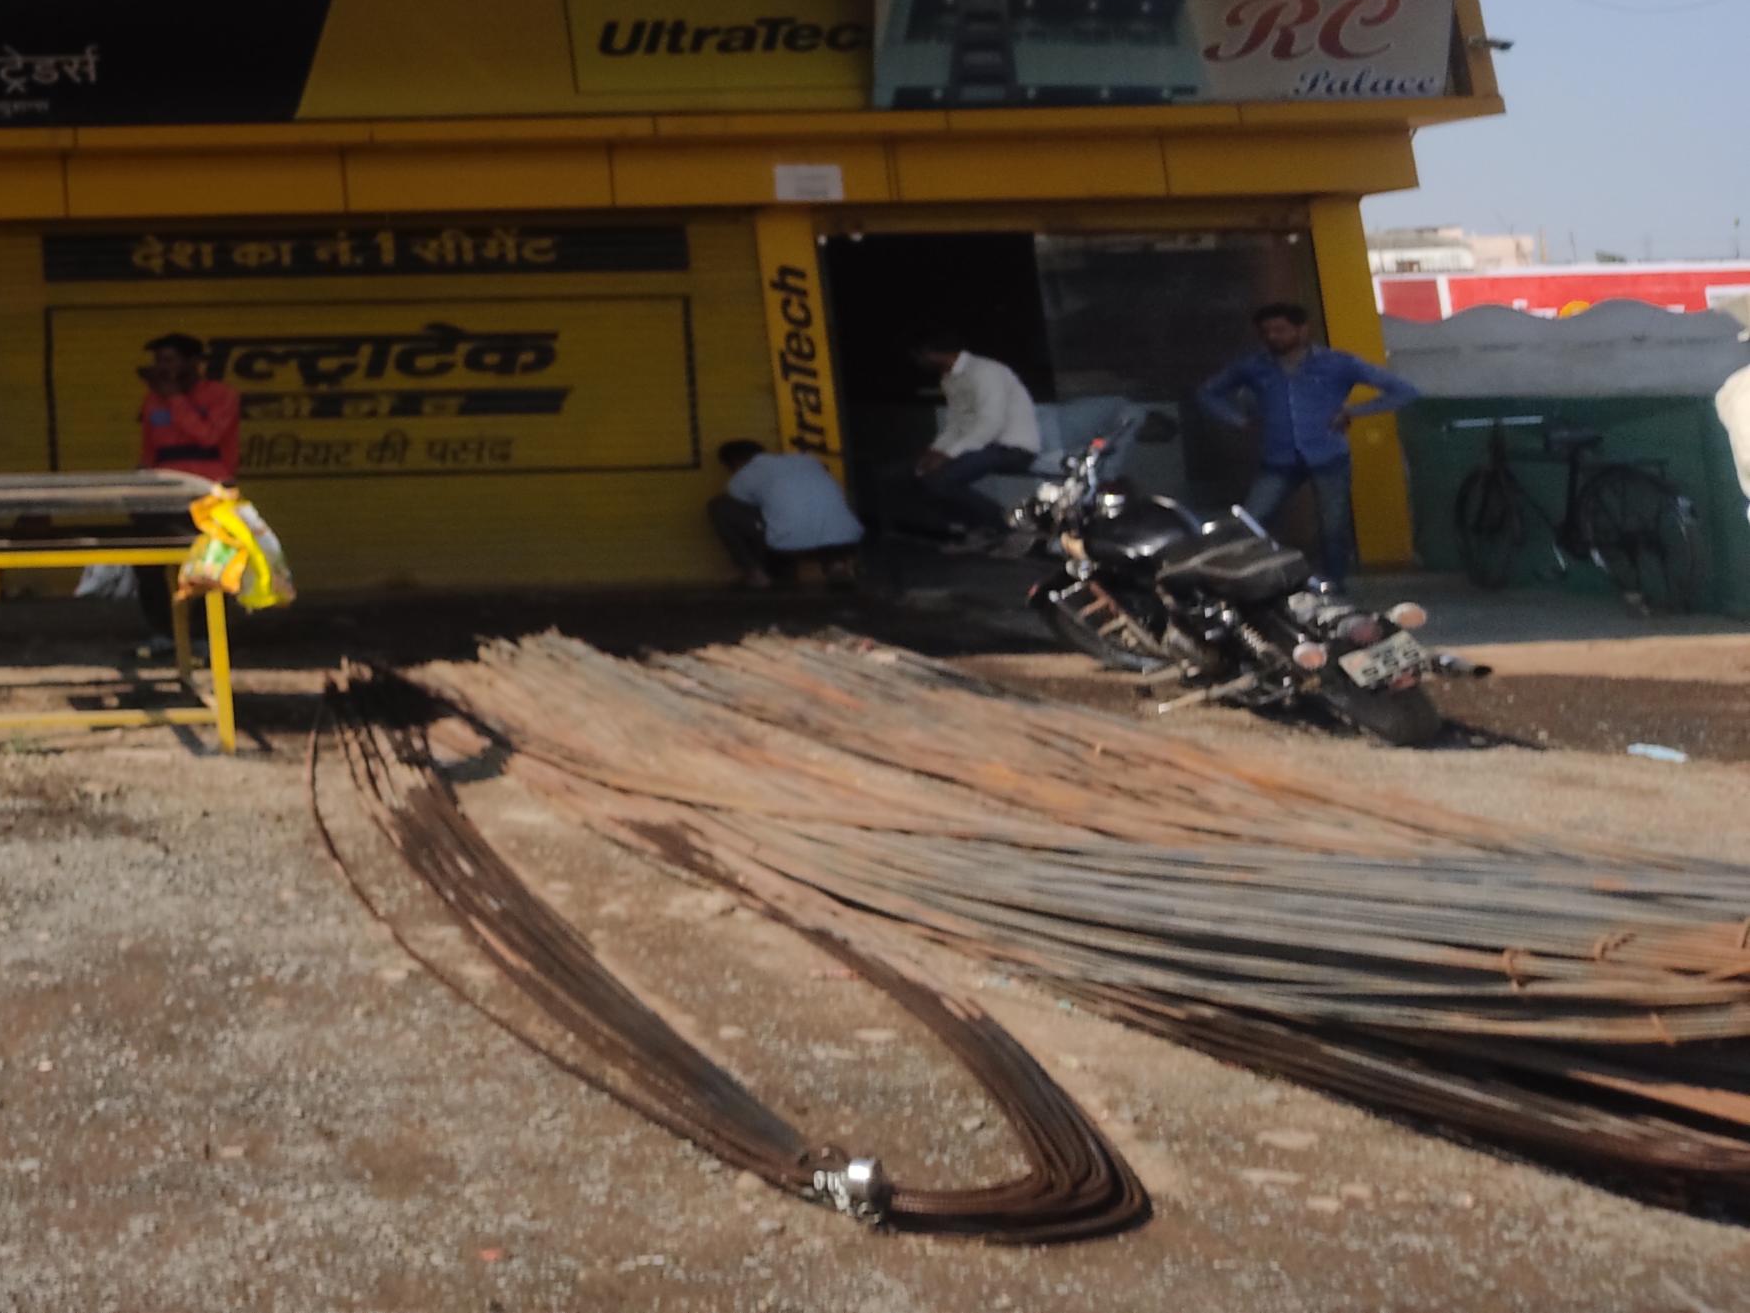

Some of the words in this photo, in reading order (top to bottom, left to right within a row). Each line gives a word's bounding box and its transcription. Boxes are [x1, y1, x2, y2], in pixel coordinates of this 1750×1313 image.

[598, 16, 874, 57] UltraTec
[1293, 68, 1435, 97] Palace
[130, 235, 216, 276] देश
[230, 237, 294, 269] का
[411, 228, 559, 265] सीमेंट
[769, 263, 830, 455] traTech
